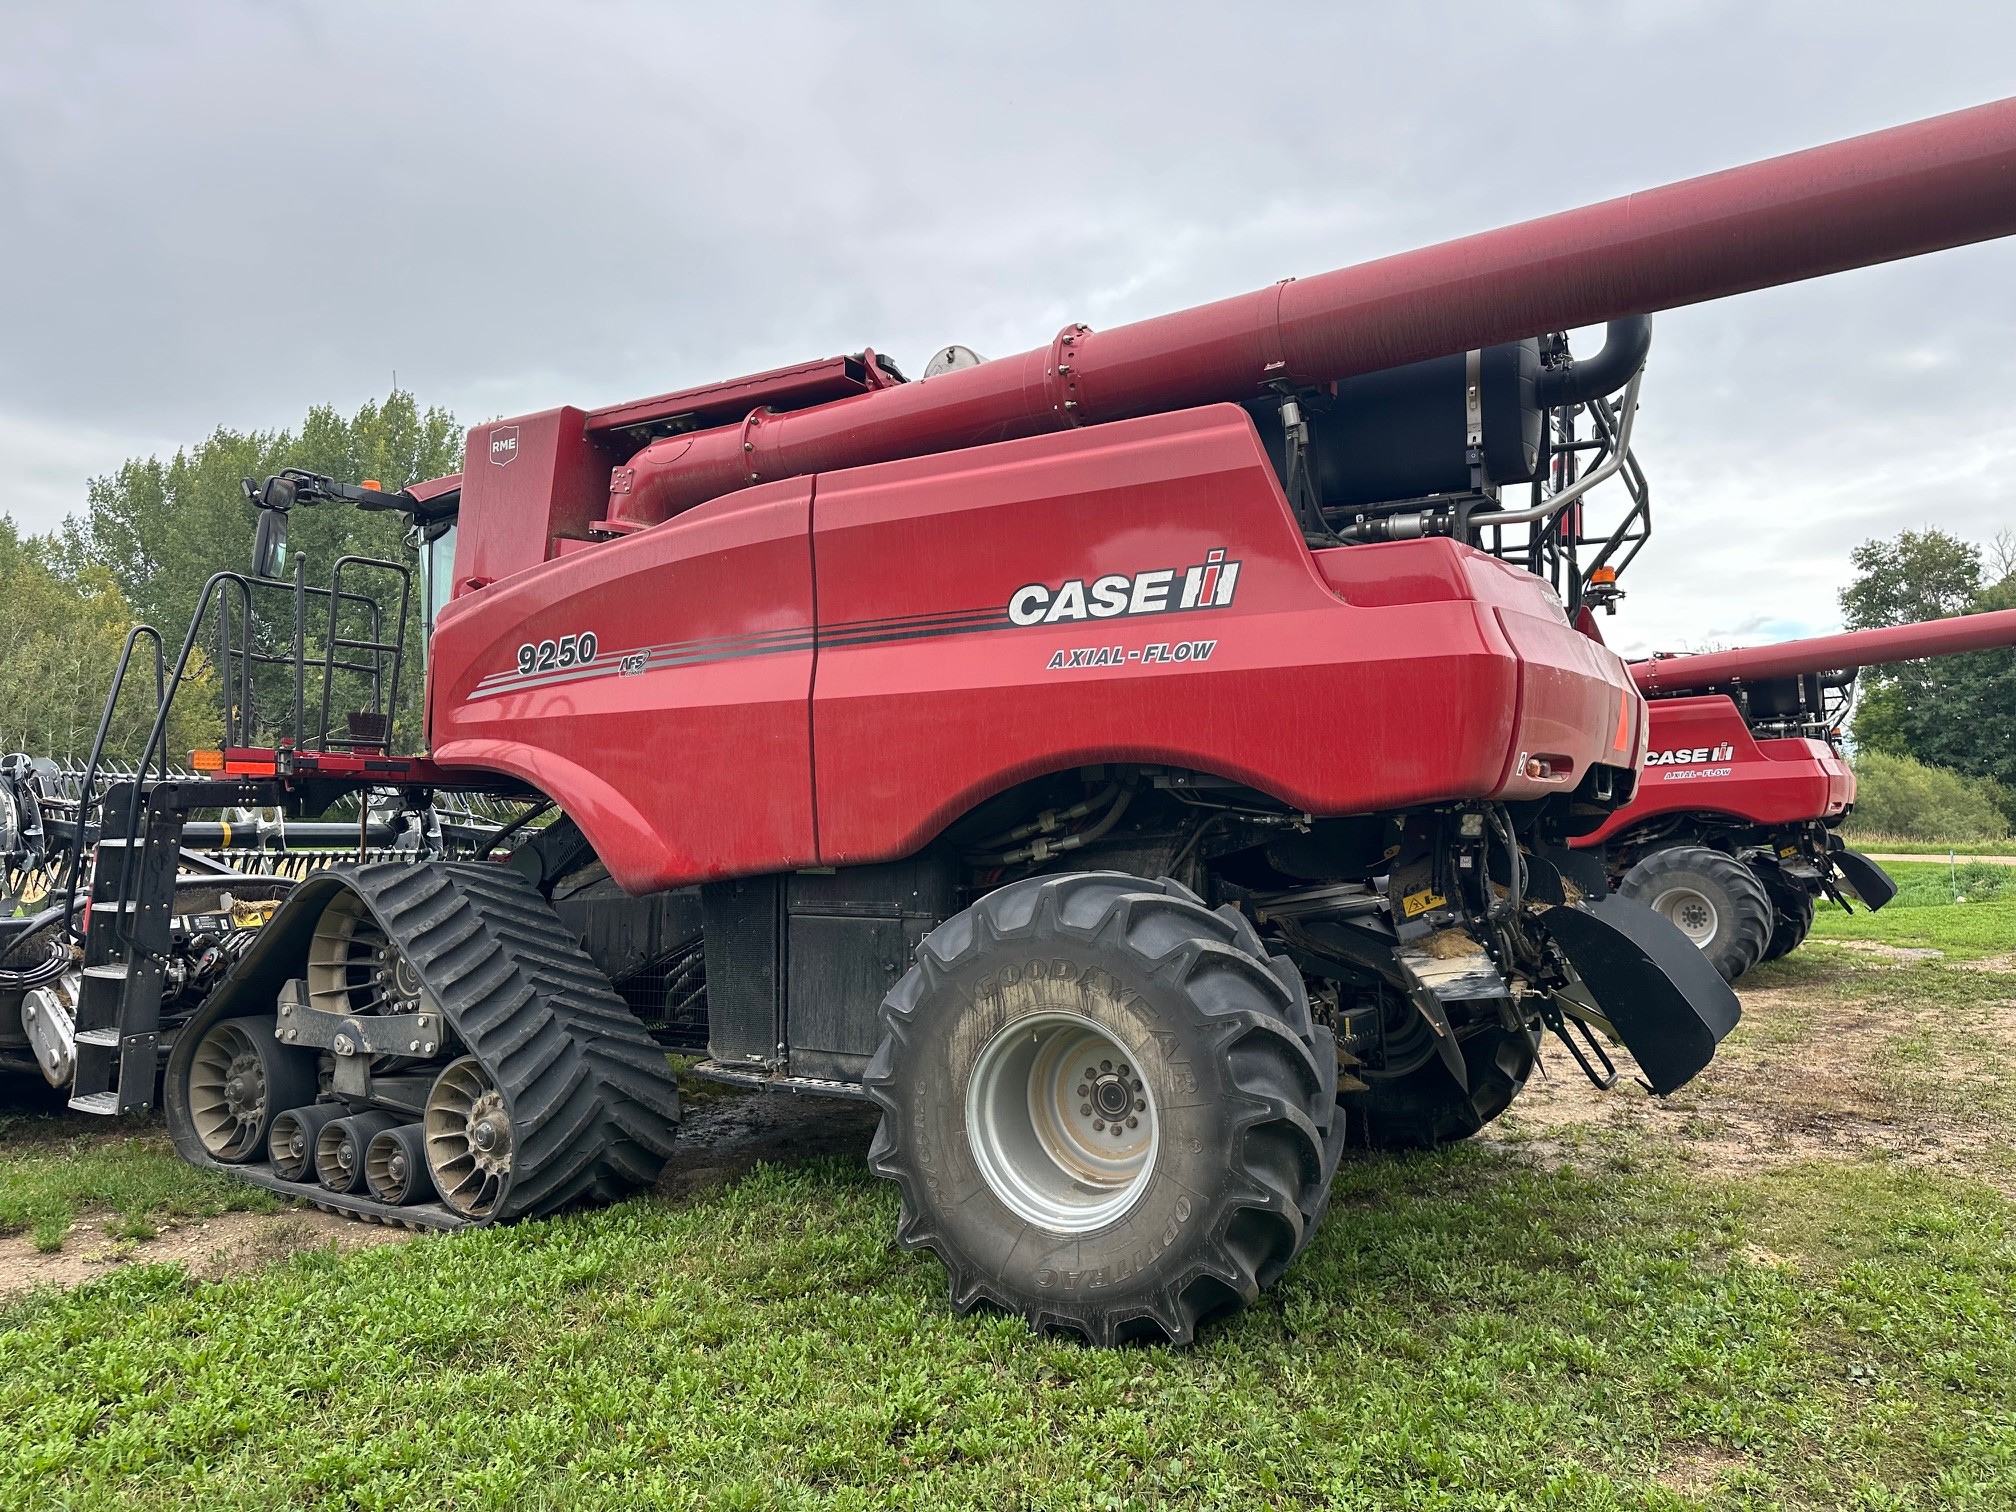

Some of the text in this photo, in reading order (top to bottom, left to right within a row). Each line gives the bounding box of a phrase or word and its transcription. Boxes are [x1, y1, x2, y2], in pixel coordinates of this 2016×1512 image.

[492, 437, 516, 453] RME
[1008, 568, 1176, 627] CASE
[518, 631, 598, 675] 9250
[618, 653, 646, 672] AFS
[1644, 747, 1709, 766] CASE
[973, 958, 1200, 1095] GOODYEAR
[1034, 1194, 1192, 1291] OPTITRAC
